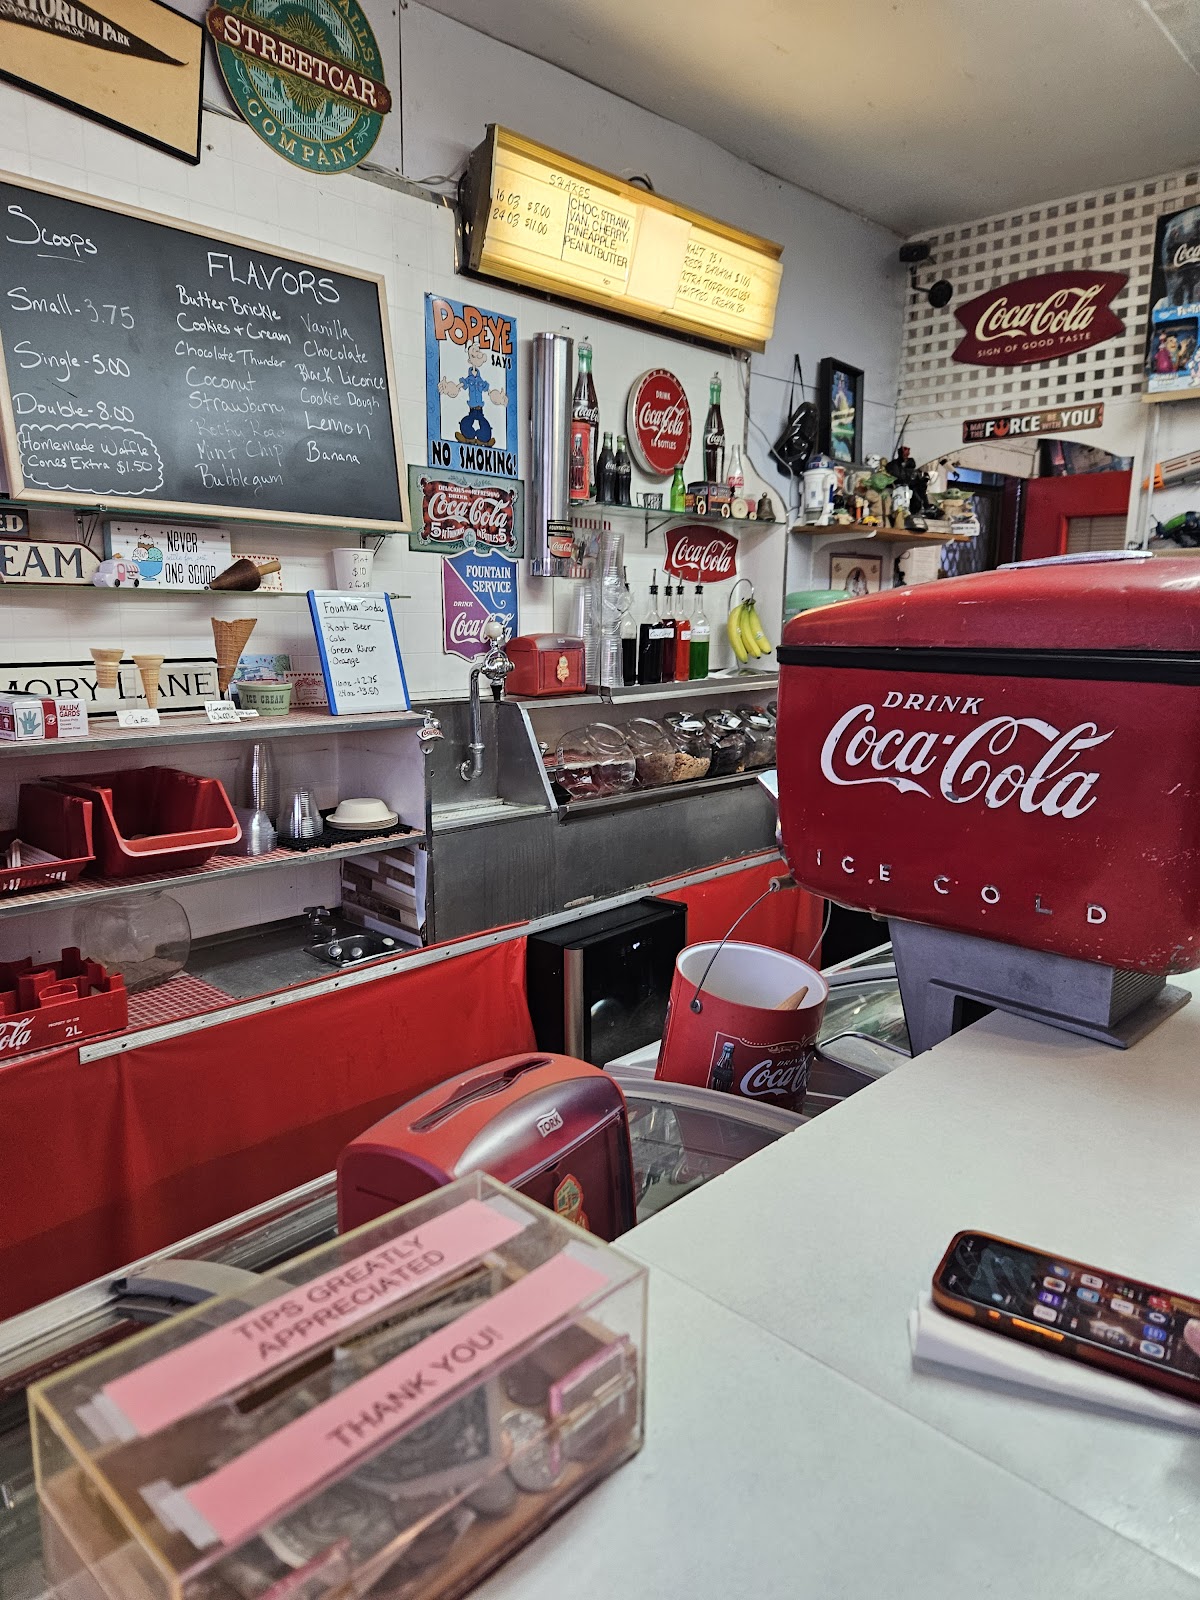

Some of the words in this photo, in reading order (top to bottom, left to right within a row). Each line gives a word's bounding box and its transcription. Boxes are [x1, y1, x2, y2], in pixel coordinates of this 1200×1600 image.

[224, 15, 377, 108] STREETCAR
[247, 98, 359, 165] COMPANY
[493, 207, 504, 220] 24
[496, 187, 505, 203] 16
[527, 201, 550, 218] $8.00
[6, 204, 98, 256] Scoops
[207, 251, 340, 304] FLAVORS
[175, 285, 228, 311] Butter
[228, 296, 281, 320] Brickle
[975, 283, 1106, 342] Coca-Cola
[177, 313, 231, 334] Cookies
[246, 323, 292, 344] Cream
[301, 313, 354, 342] Vanilla
[432, 299, 513, 355] POPEYE
[175, 341, 234, 363] Chocolate
[236, 350, 286, 368] Thunder
[303, 341, 368, 363] Chocolate
[977, 348, 1001, 357] SIGN
[1004, 344, 1018, 352] OF
[1022, 338, 1054, 349] GOOD
[1059, 332, 1091, 343] TASTE
[491, 354, 512, 370] SAYS
[186, 366, 256, 392] Coconut
[295, 364, 334, 384] Black
[338, 366, 386, 390] Licorice
[300, 387, 341, 406] Cookie
[347, 392, 380, 415] Dough
[655, 390, 671, 400] DRINK
[305, 411, 371, 440] Lemon
[639, 401, 687, 436] Coca-Cola
[970, 423, 984, 431] MAY
[1061, 407, 1096, 428] YOU
[22, 431, 95, 452] Homemade
[100, 436, 150, 457] Waffle
[657, 439, 677, 450] BOTTLES
[970, 431, 984, 439] THE
[27, 454, 67, 469] Cones
[70, 456, 110, 471] Extra
[116, 459, 153, 475] $1.50
[196, 439, 237, 461] Mint
[246, 440, 283, 467] Chip
[306, 441, 360, 465] Banana
[431, 440, 451, 466] NO
[460, 446, 517, 475] SMOKING!
[428, 491, 510, 528] Coca-Cola
[352, 553, 369, 564] Pint
[671, 535, 736, 573] Coca-Cola
[352, 566, 367, 577] $10
[466, 564, 512, 579] FOUNTAIN
[472, 580, 512, 594] SERVICE
[323, 601, 359, 614] Fountain
[326, 621, 349, 631] Root
[352, 622, 371, 631] Beer
[450, 611, 515, 644] Coca-Cla
[331, 645, 353, 654] Green
[332, 656, 360, 667] Orange
[246, 694, 257, 704] ICE
[260, 694, 285, 704] CREAM
[882, 691, 984, 715] DRINK
[820, 703, 1118, 819] Coca-Cola
[816, 848, 892, 882] ICE
[933, 874, 1108, 925] COLD
[65, 1025, 83, 1038] 2L
[539, 1116, 562, 1134] TORK
[231, 1299, 304, 1341] TIPS
[306, 1235, 425, 1304] GREATLY
[257, 1249, 446, 1361] APPRECIATED
[324, 1370, 438, 1449] THANK
[429, 1324, 505, 1374] YOU!
